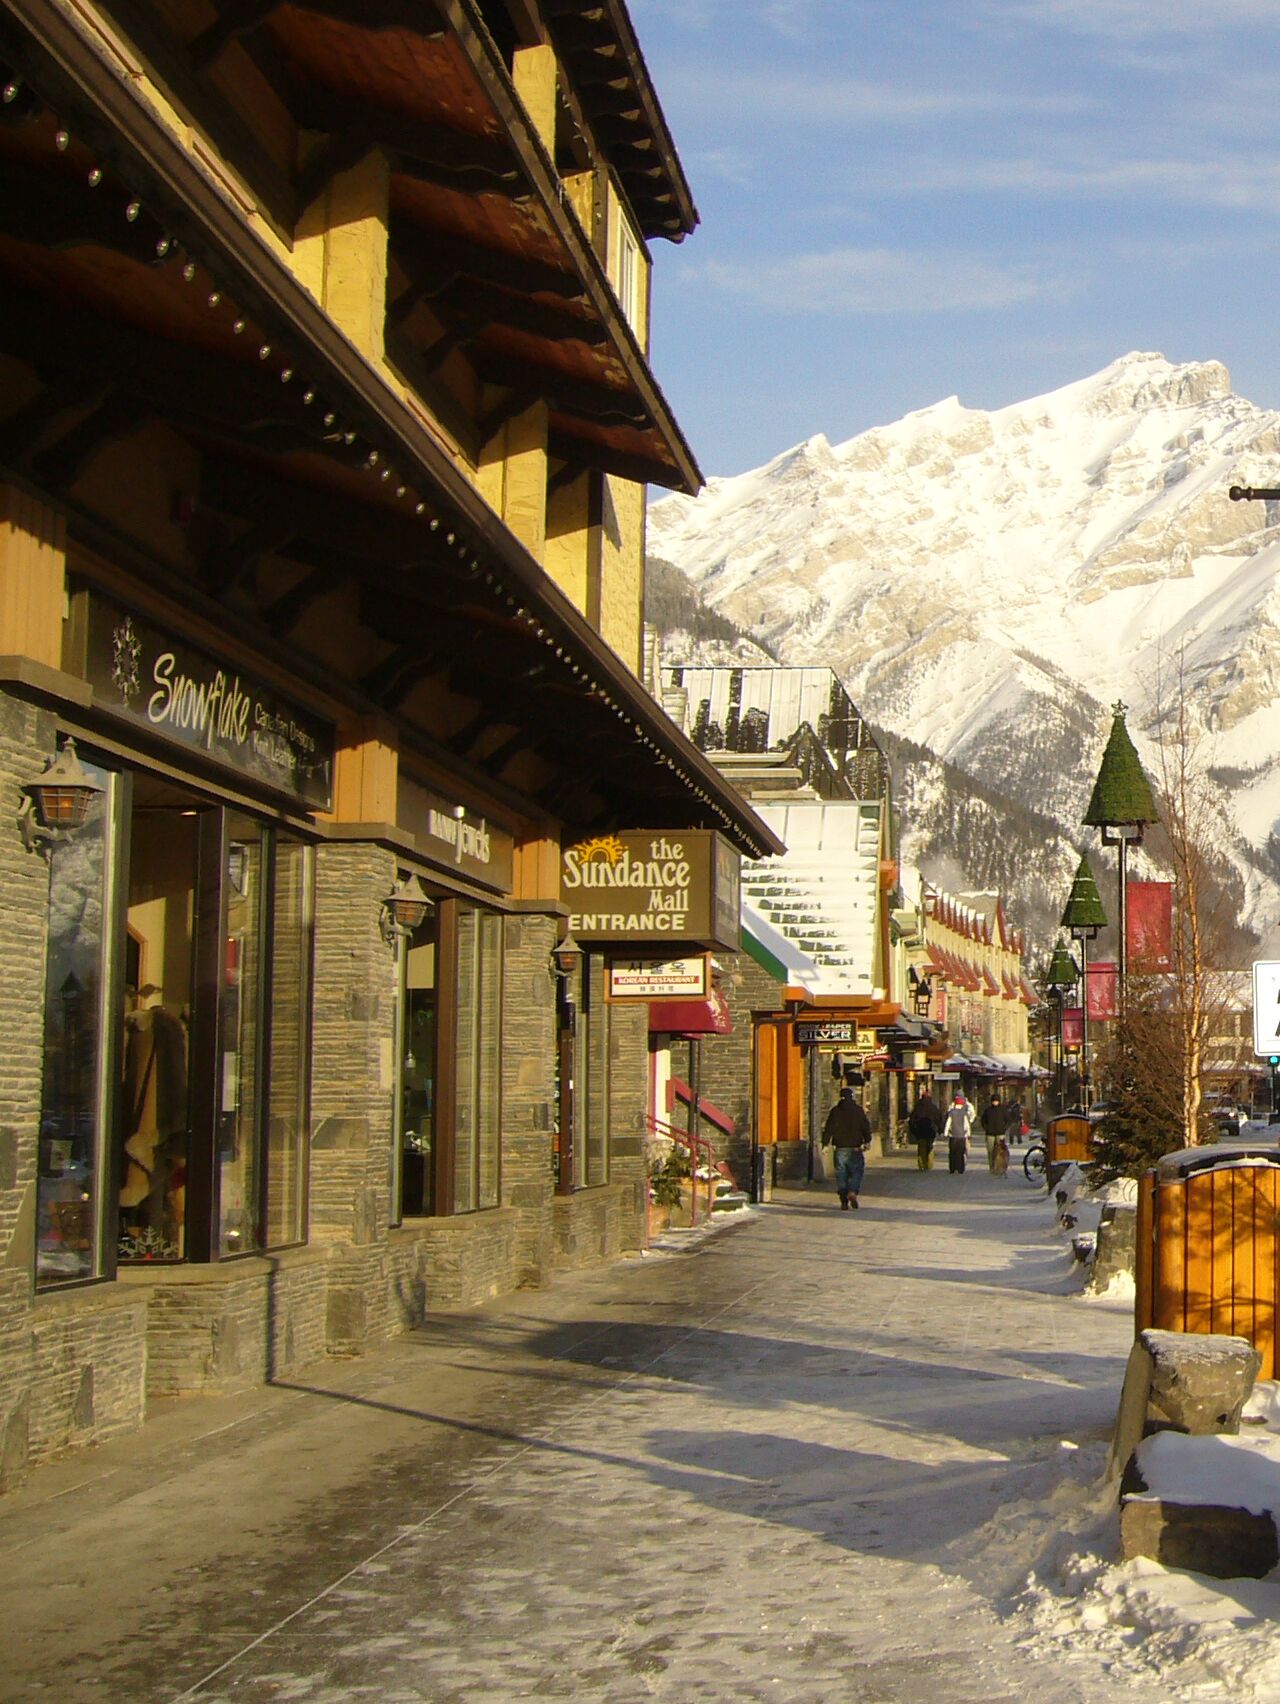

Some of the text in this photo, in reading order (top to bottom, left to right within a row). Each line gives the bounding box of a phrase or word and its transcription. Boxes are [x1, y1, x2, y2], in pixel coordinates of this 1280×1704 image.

[148, 652, 250, 750] Snowflake
[650, 838, 684, 860] the
[562, 850, 690, 888] Sundance
[647, 889, 690, 912] Mall
[567, 914, 686, 931] ENTRANCE
[798, 1029, 852, 1041] SILVER
